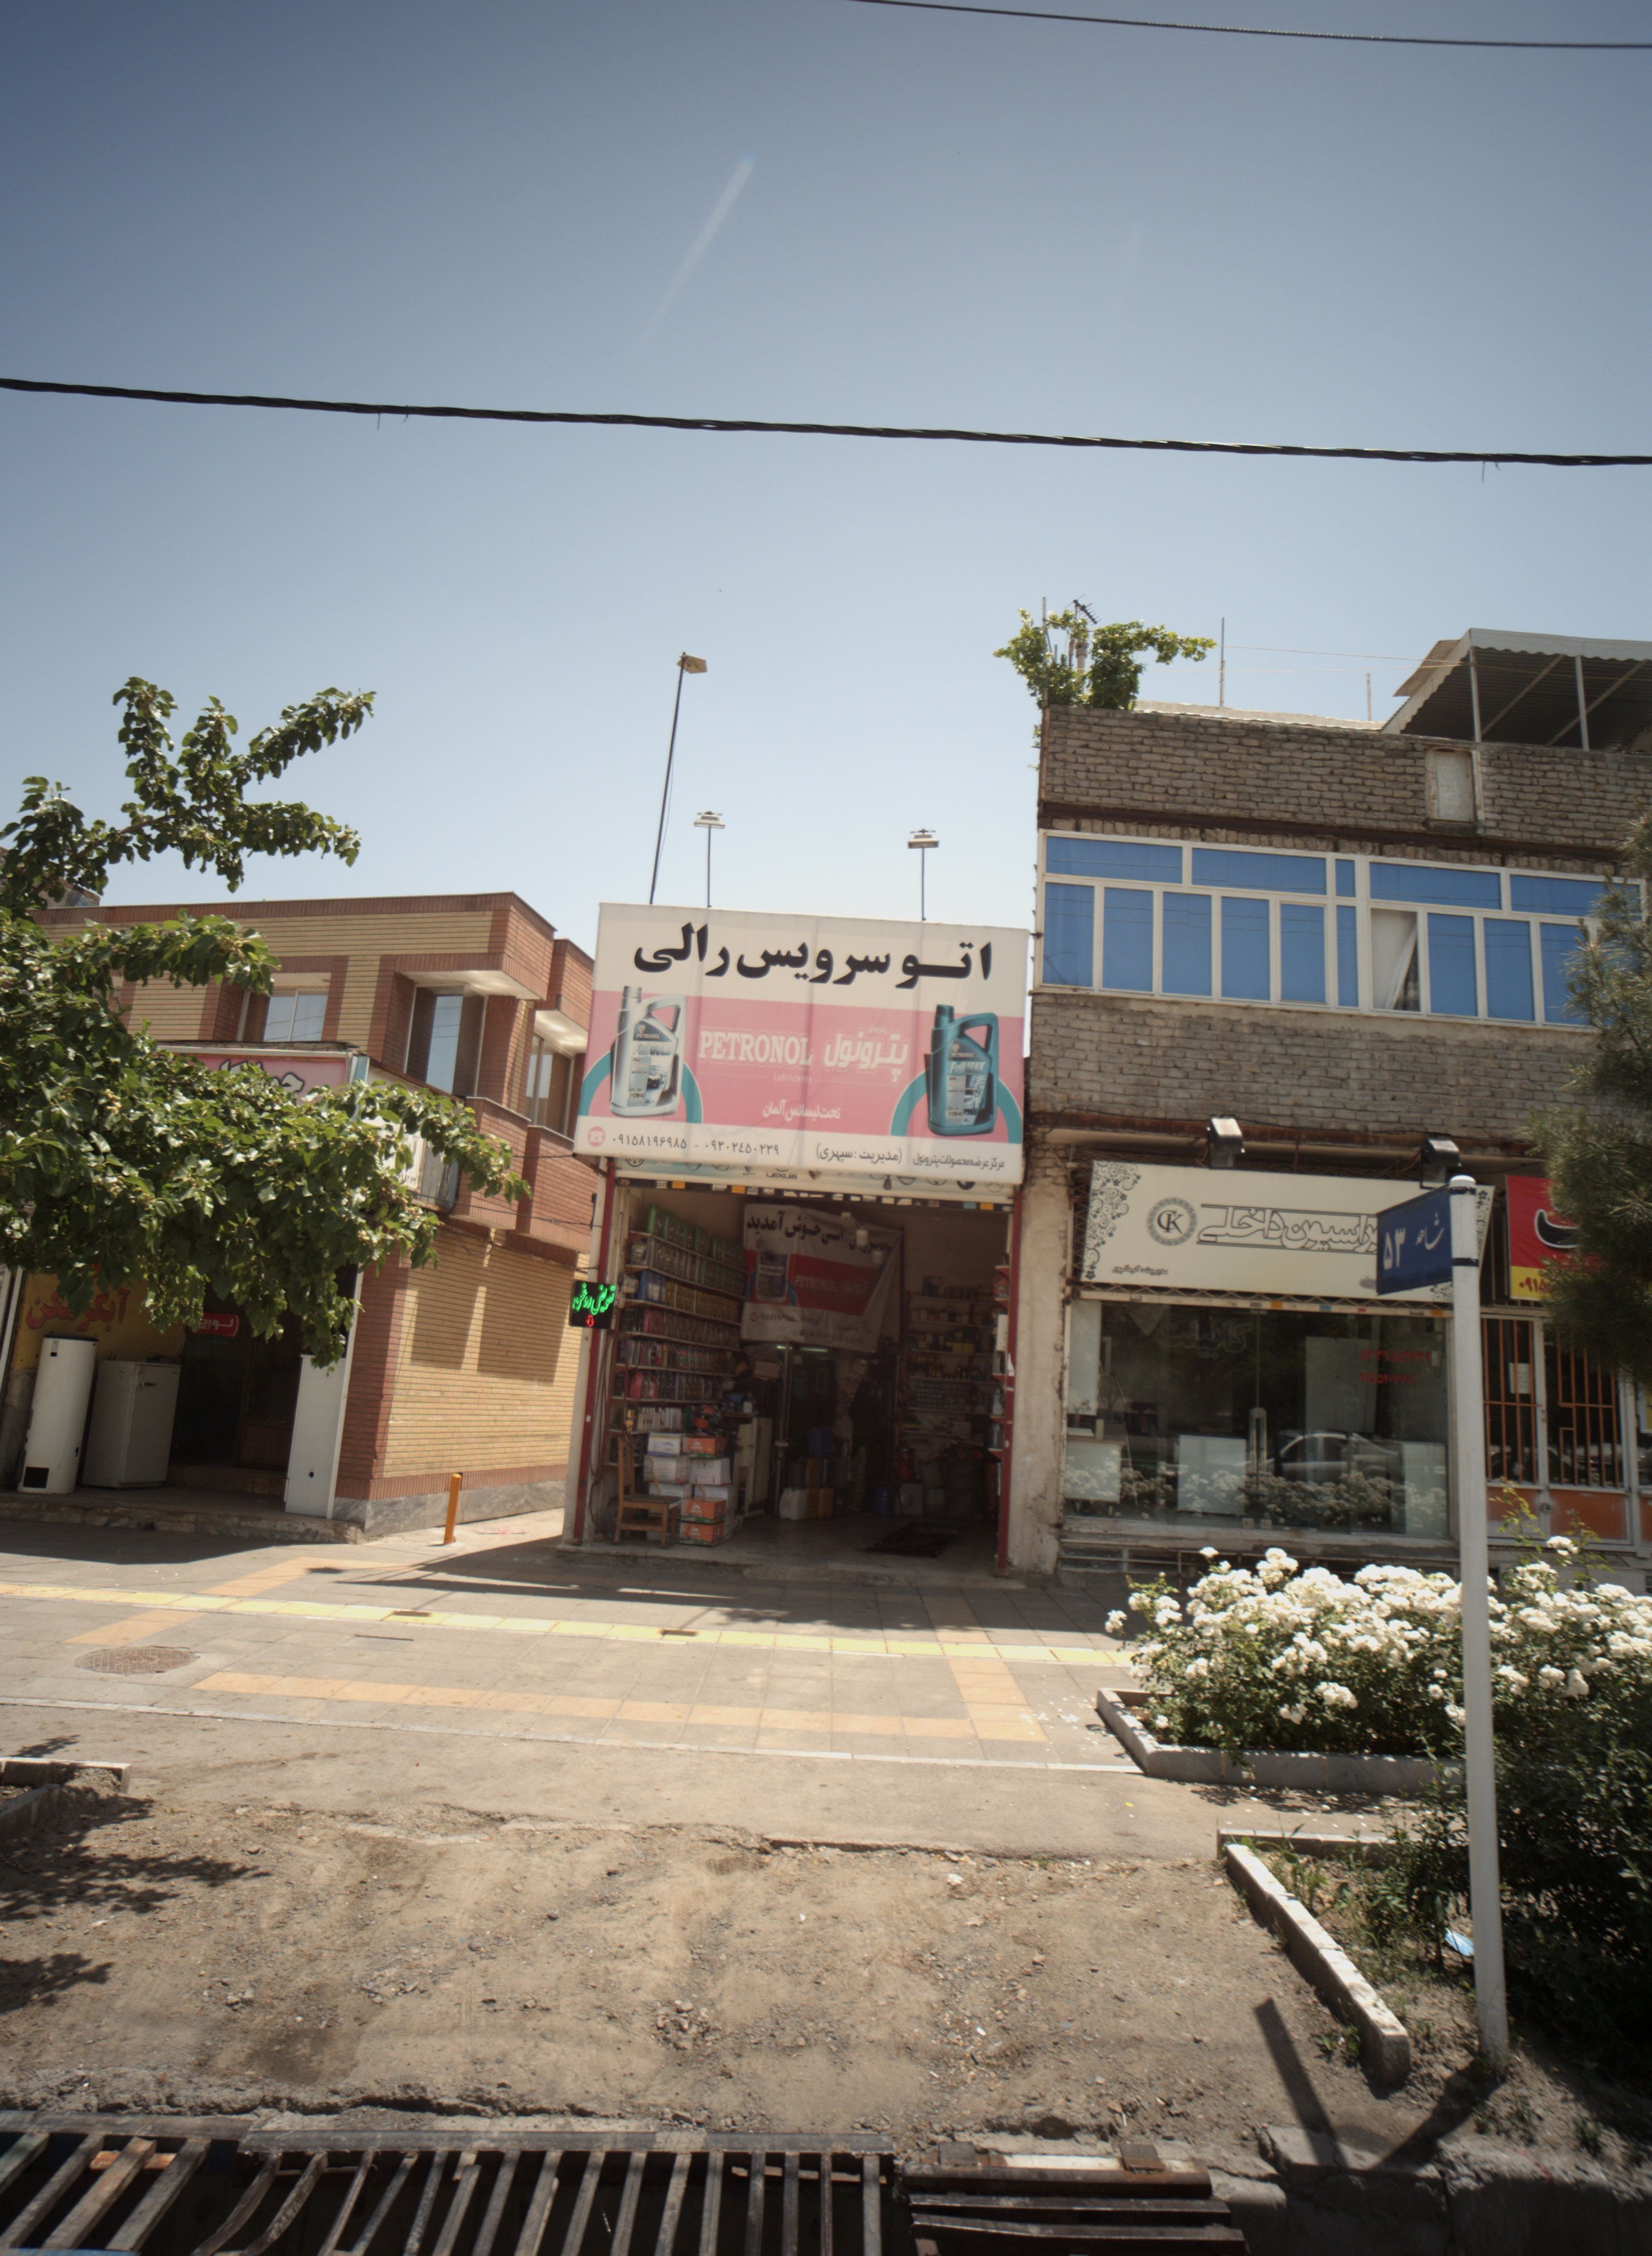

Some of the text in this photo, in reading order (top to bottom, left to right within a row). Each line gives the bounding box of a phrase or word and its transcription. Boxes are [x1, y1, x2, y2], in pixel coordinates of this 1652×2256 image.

[634, 921, 992, 989] اتو سرویس رالی
[698, 1031, 813, 1065] PETRONOL
[824, 1032, 909, 1083] پترونول
[763, 1099, 841, 1122] تحت لیسانس آلمان
[612, 1134, 687, 1149] ۰۹۱۵۸۱۹۶۹۸۵
[913, 1153, 1005, 1170] مرکز عرضه محصولات پترونول
[746, 1211, 786, 1235] آمدید
[785, 1217, 822, 1239] خوش
[1198, 1205, 1378, 1252] راسیون داخلی
[1383, 1226, 1406, 1271] ۵۳
[572, 1282, 616, 1315] تعویض روغن
